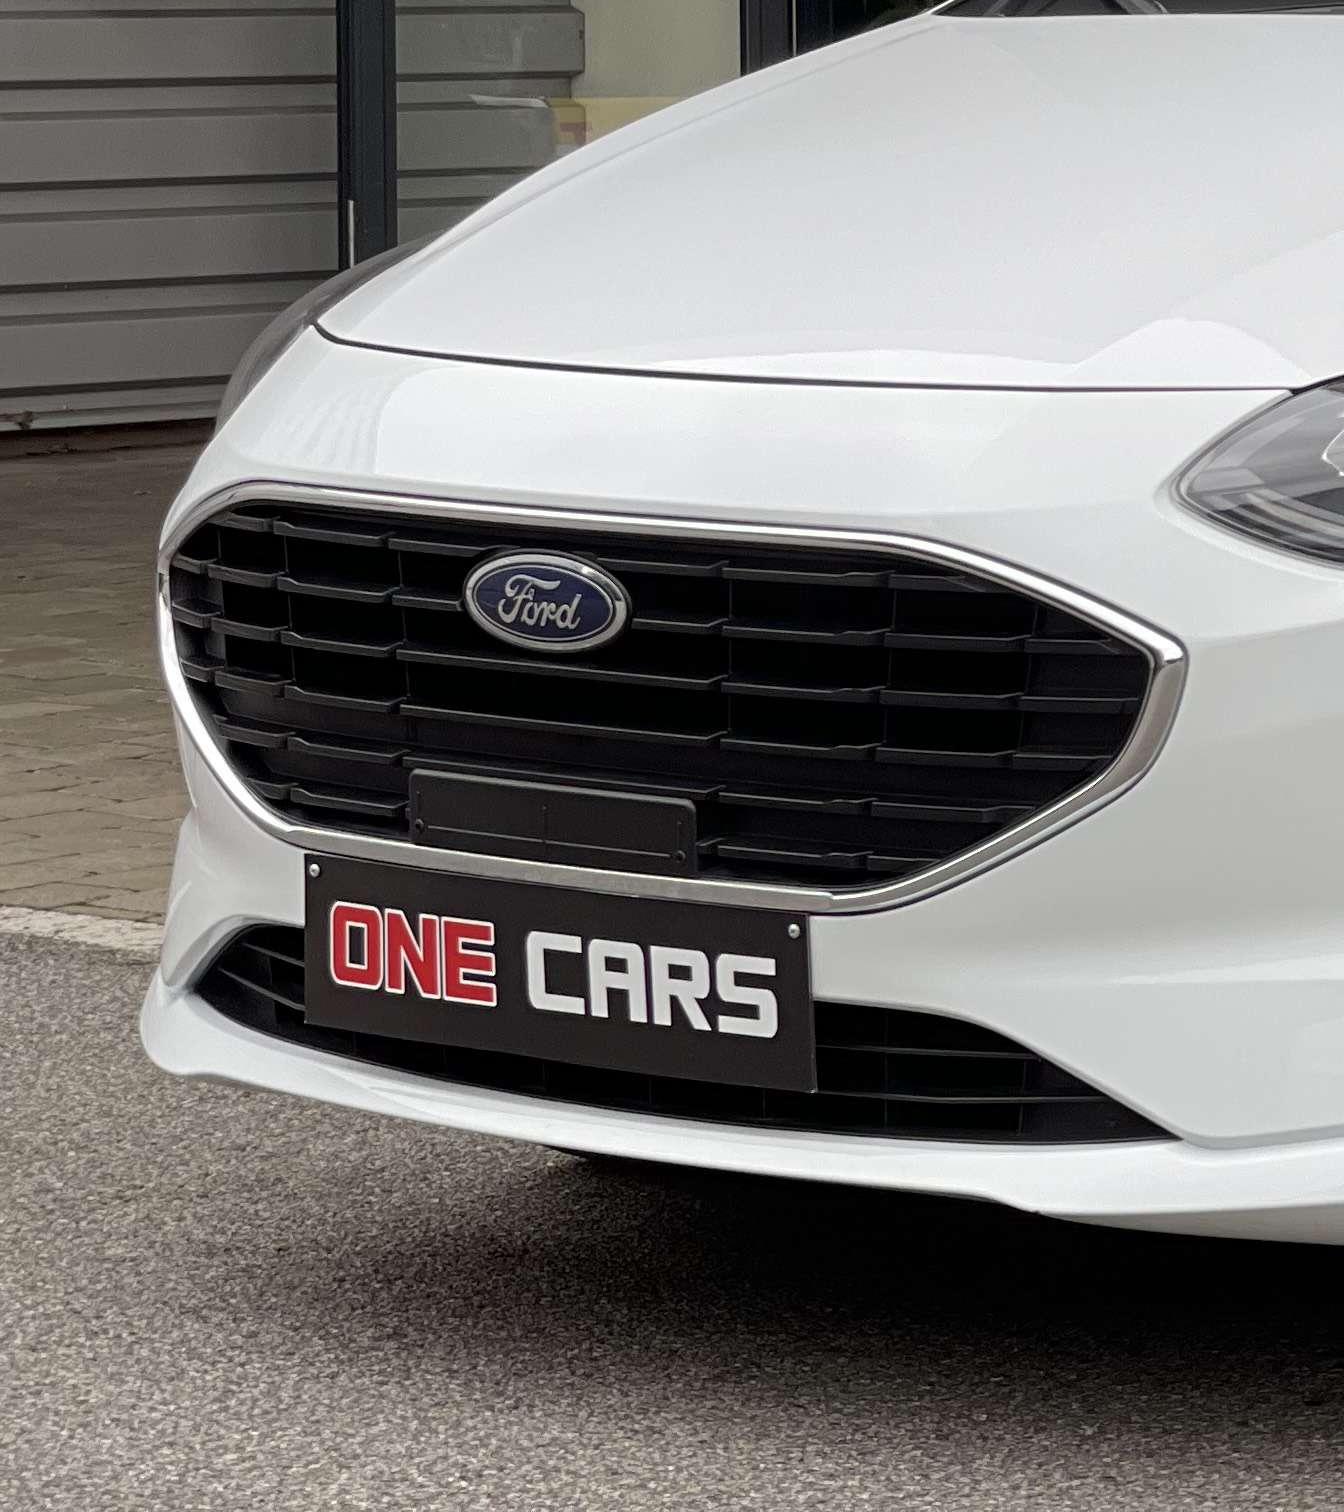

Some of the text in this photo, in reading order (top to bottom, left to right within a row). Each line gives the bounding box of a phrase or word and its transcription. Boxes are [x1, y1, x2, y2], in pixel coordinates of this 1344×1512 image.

[497, 573, 583, 630] Ford
[330, 900, 779, 1039] ONE CARS
